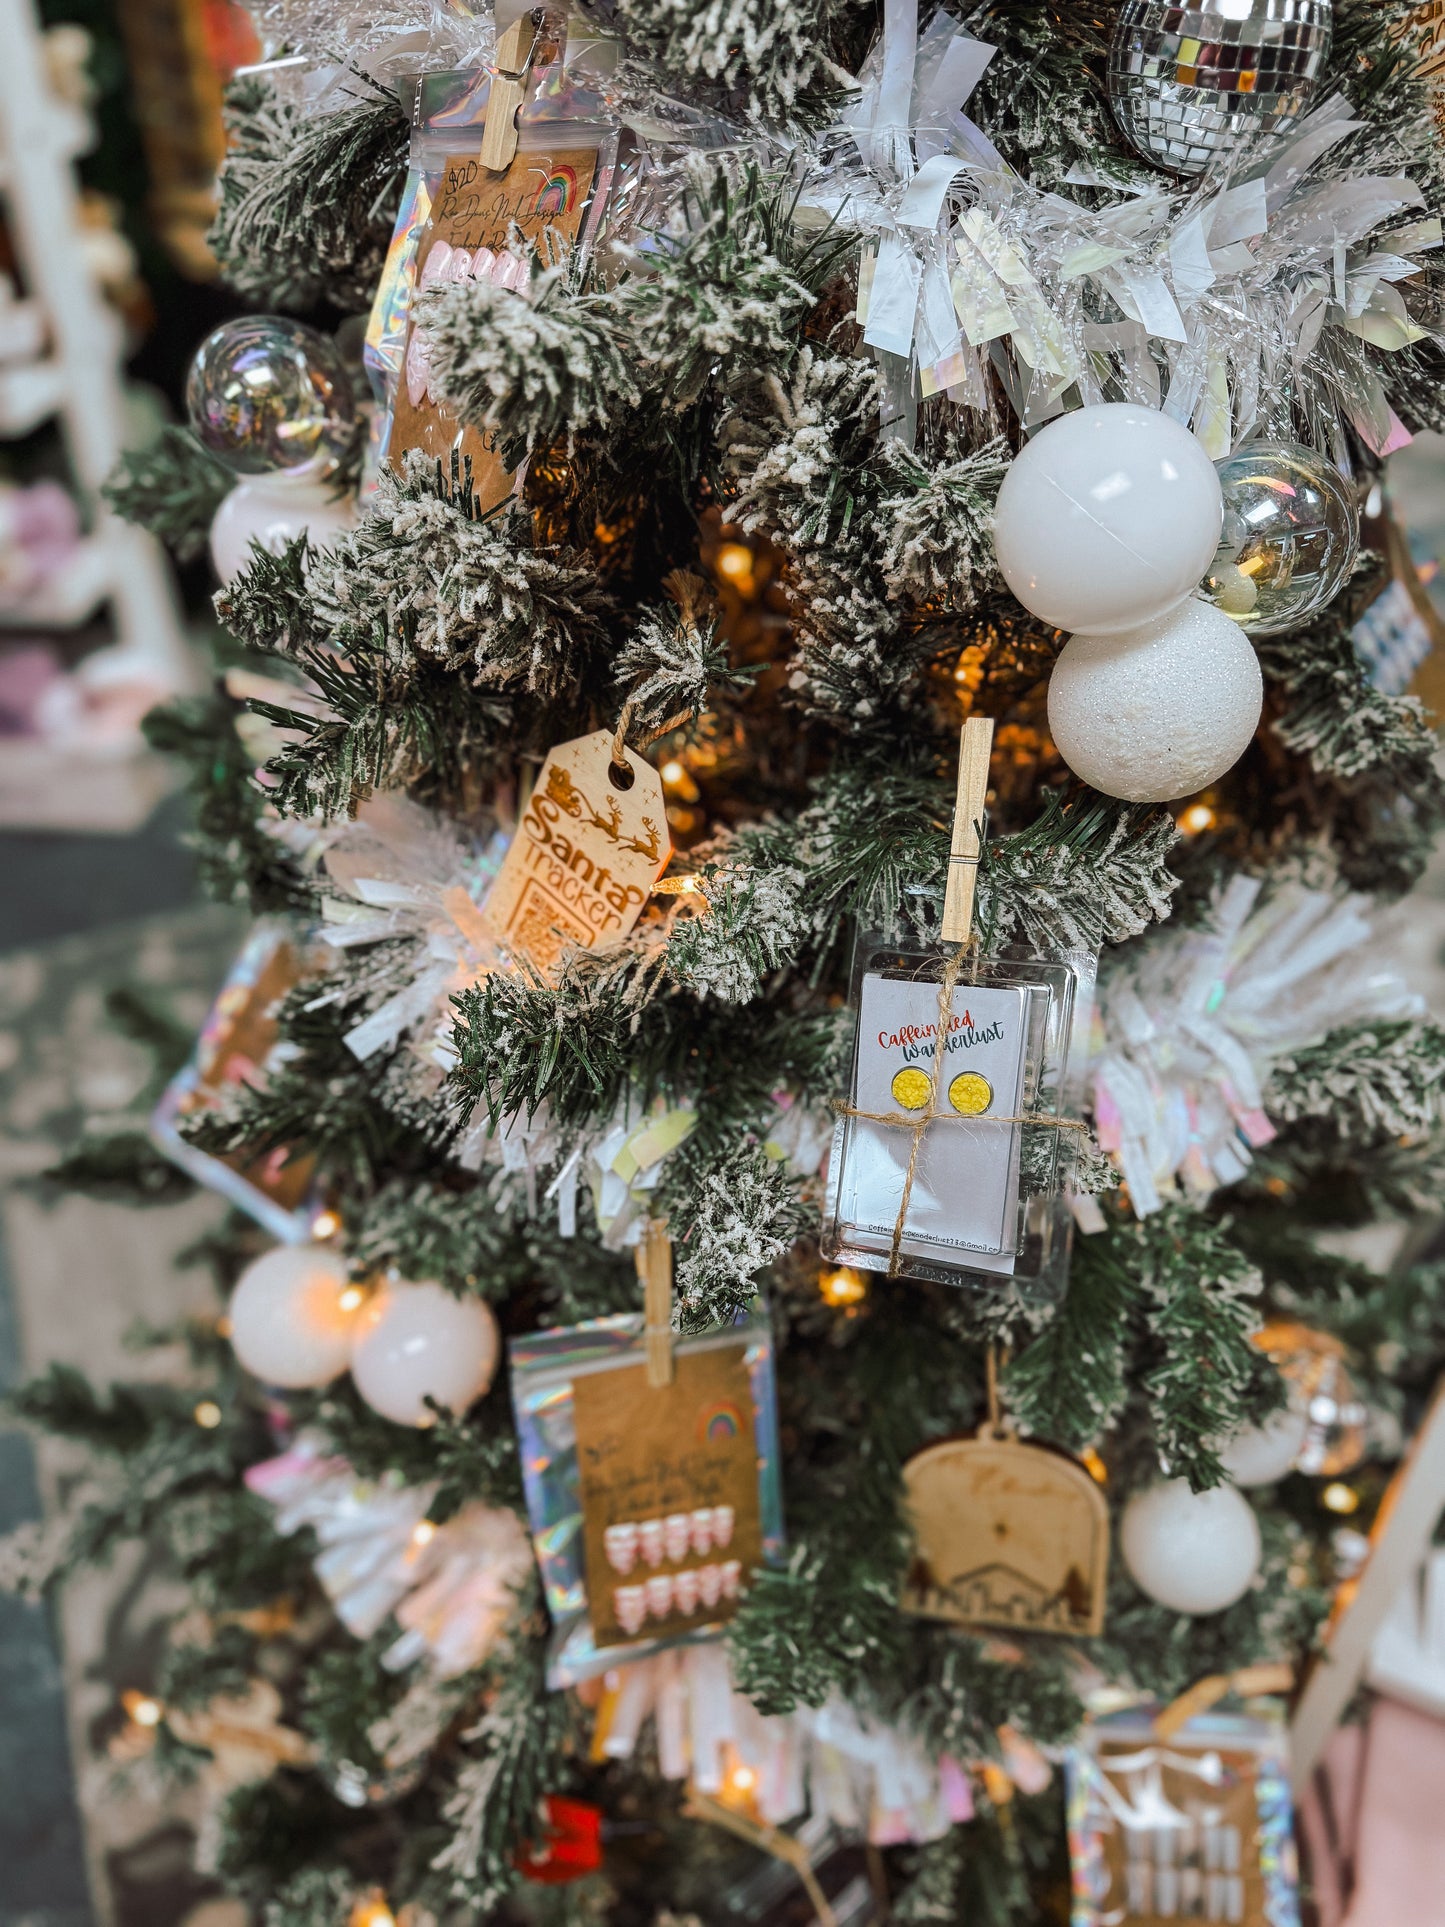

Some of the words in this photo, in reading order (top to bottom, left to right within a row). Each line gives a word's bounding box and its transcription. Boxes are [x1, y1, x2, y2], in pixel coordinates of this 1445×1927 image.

[445, 160, 478, 195] $20
[491, 192, 524, 226] Nail
[523, 793, 645, 914] Santa
[524, 840, 622, 931] Tracker
[877, 1009, 975, 1049] Caffeinted
